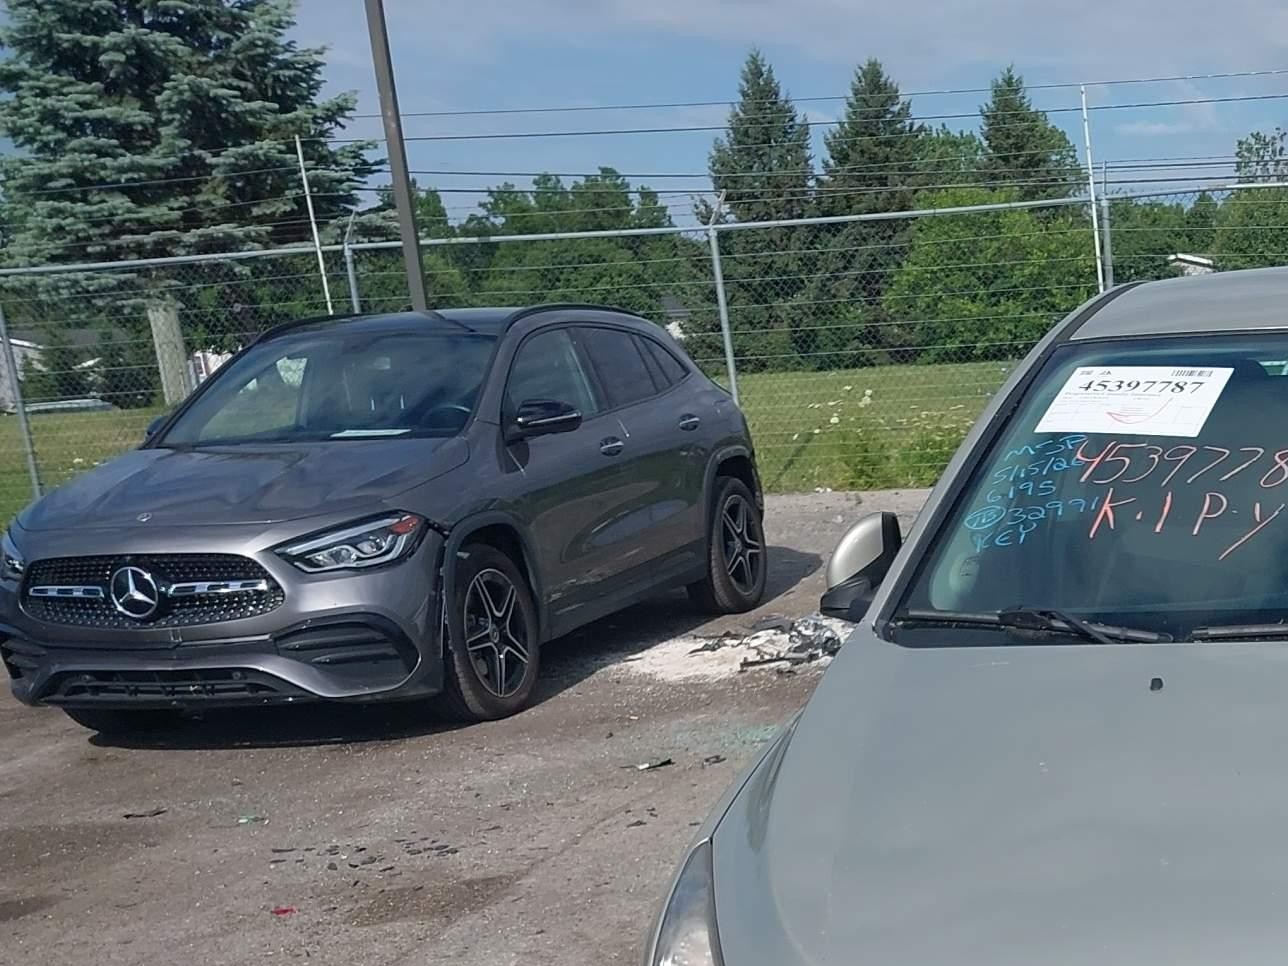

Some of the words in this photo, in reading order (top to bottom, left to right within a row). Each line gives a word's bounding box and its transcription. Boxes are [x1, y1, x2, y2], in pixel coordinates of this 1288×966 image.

[1079, 380, 1208, 394] 45397787
[986, 480, 1057, 503] 6195
[973, 521, 1038, 554] KEY
